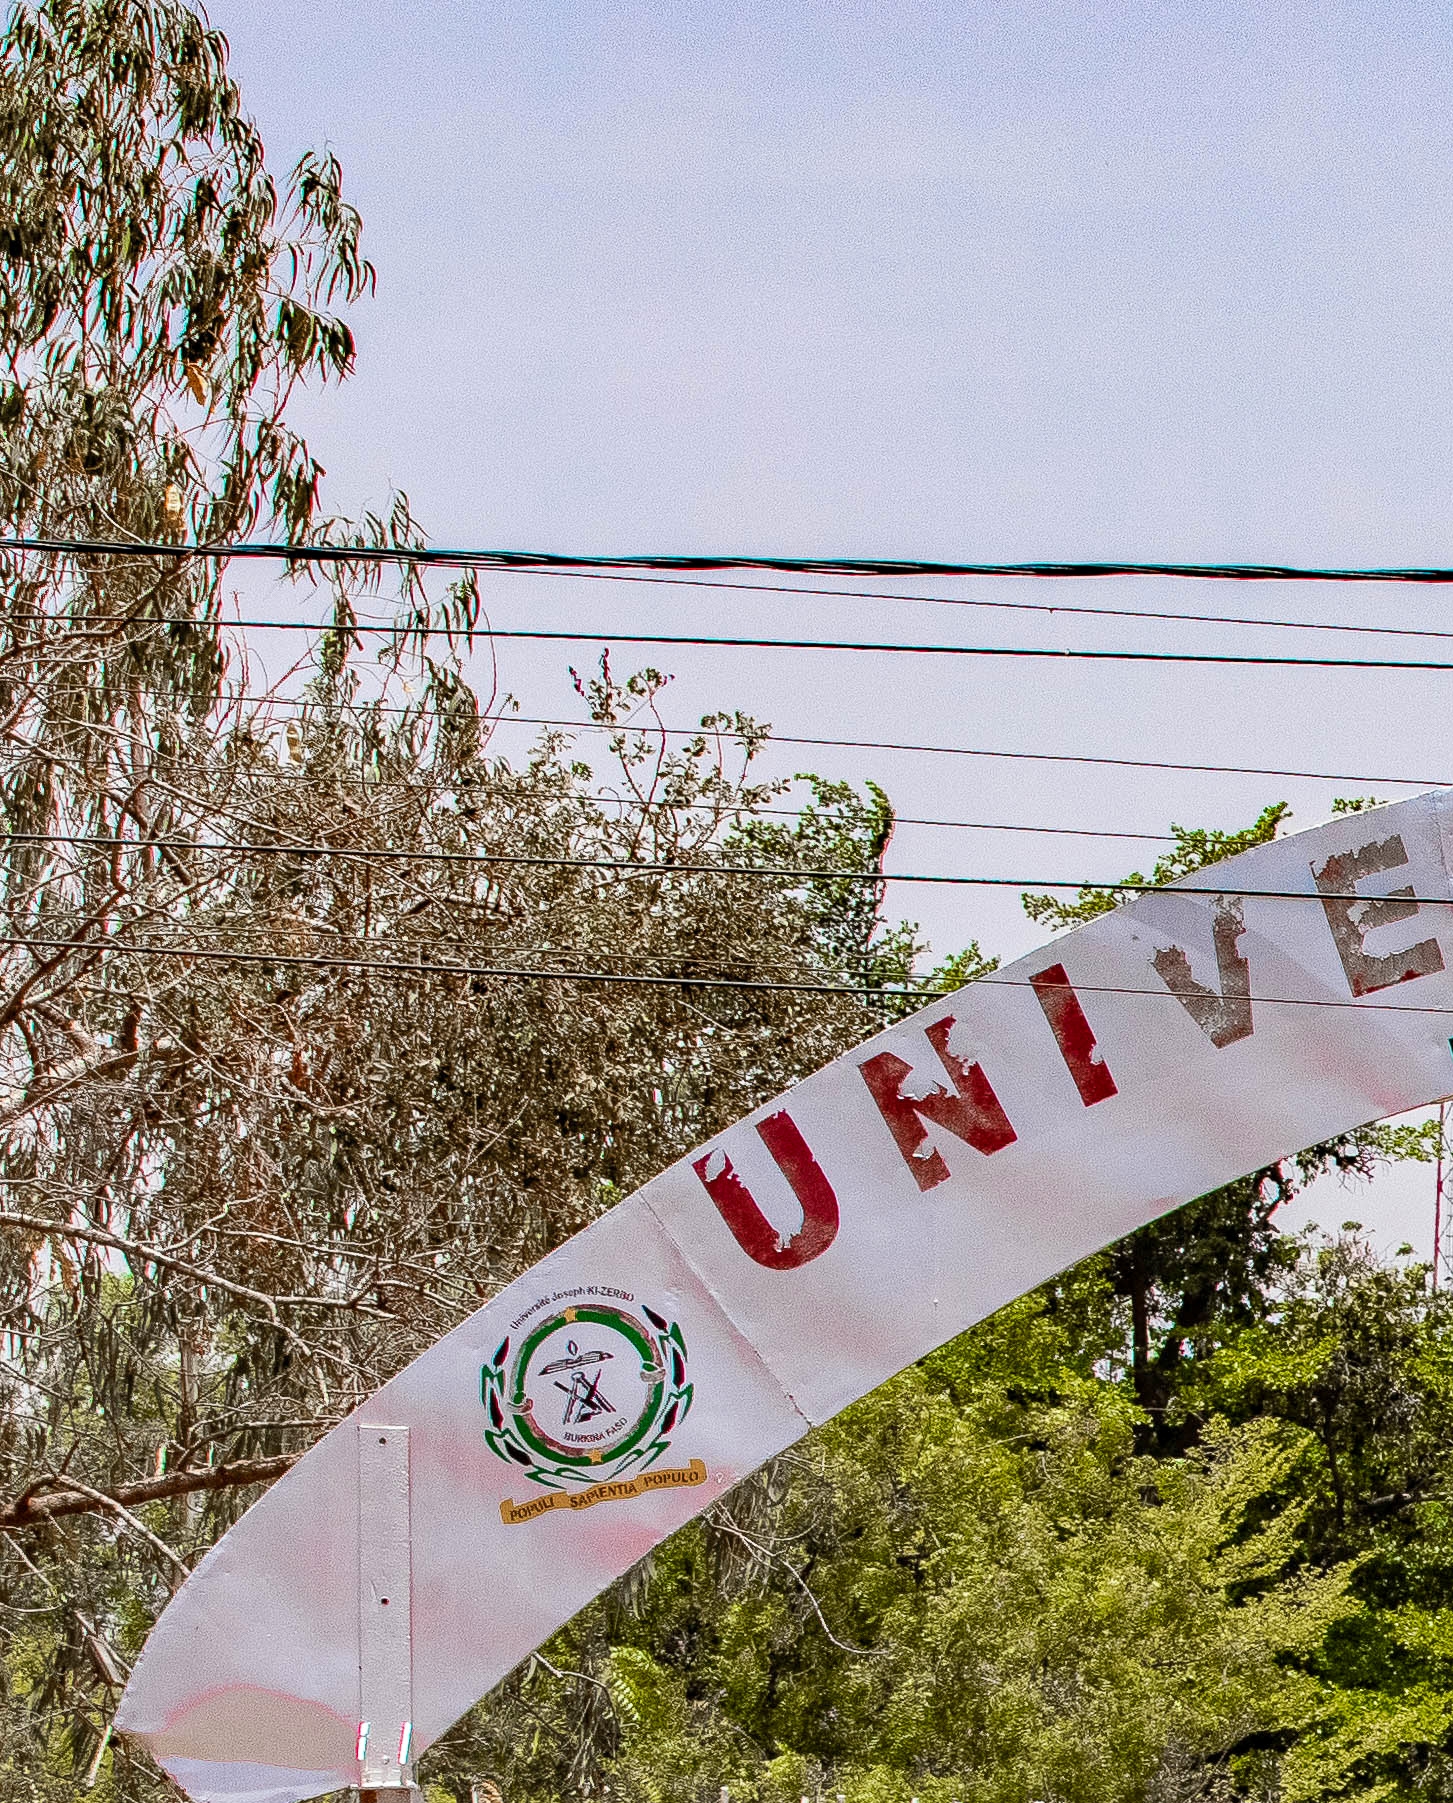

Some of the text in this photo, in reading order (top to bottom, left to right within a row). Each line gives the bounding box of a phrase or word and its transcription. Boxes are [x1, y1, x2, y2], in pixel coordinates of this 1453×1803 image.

[509, 1471, 699, 1521] POPULI SAPIENTIA POPULO
